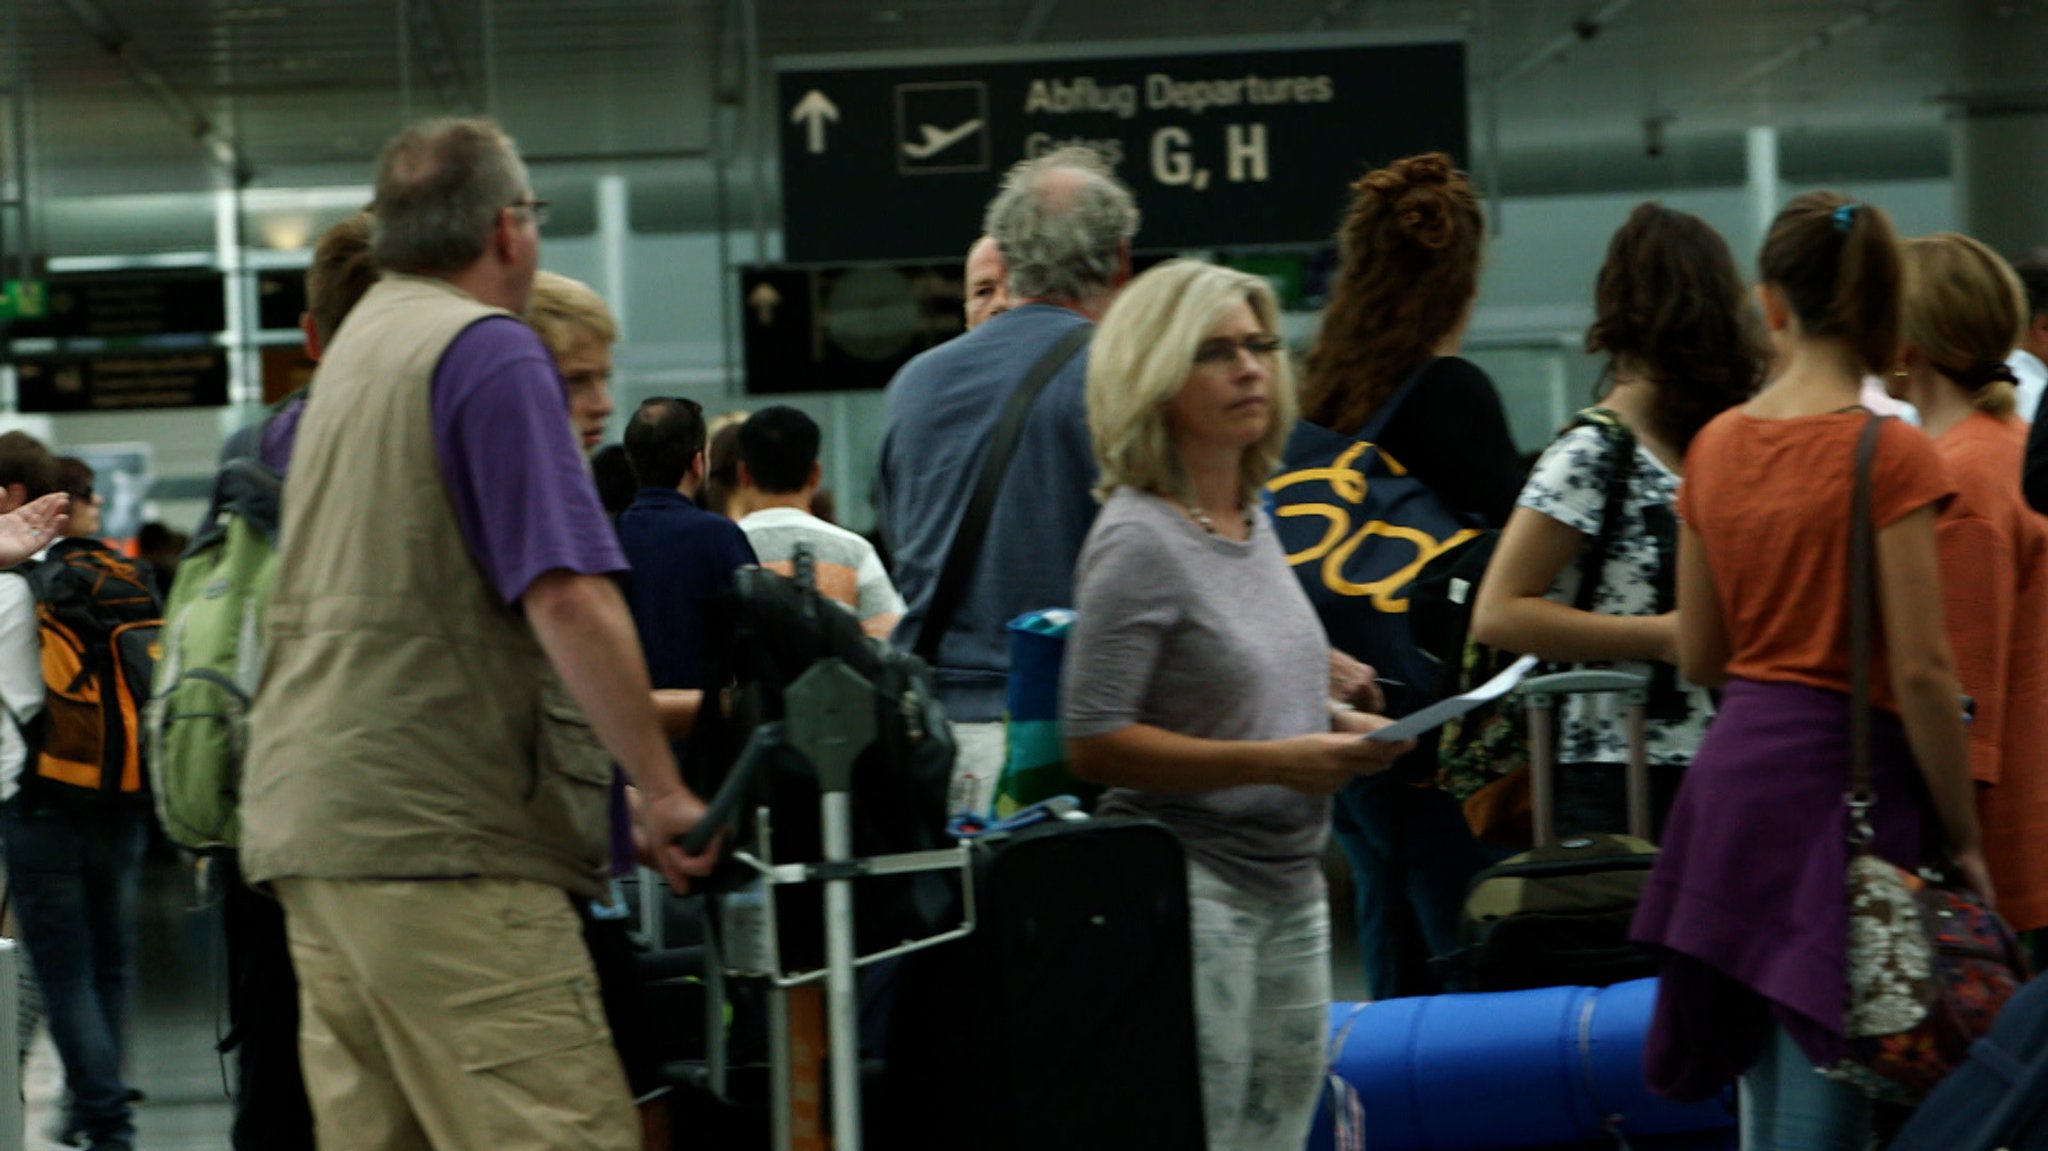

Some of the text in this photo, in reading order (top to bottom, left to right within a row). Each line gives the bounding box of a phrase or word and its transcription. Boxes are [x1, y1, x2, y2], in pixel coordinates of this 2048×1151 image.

[1024, 73, 1334, 119] Abflug Departures
[1152, 126, 1212, 191] G,
[1225, 121, 1269, 182] H
